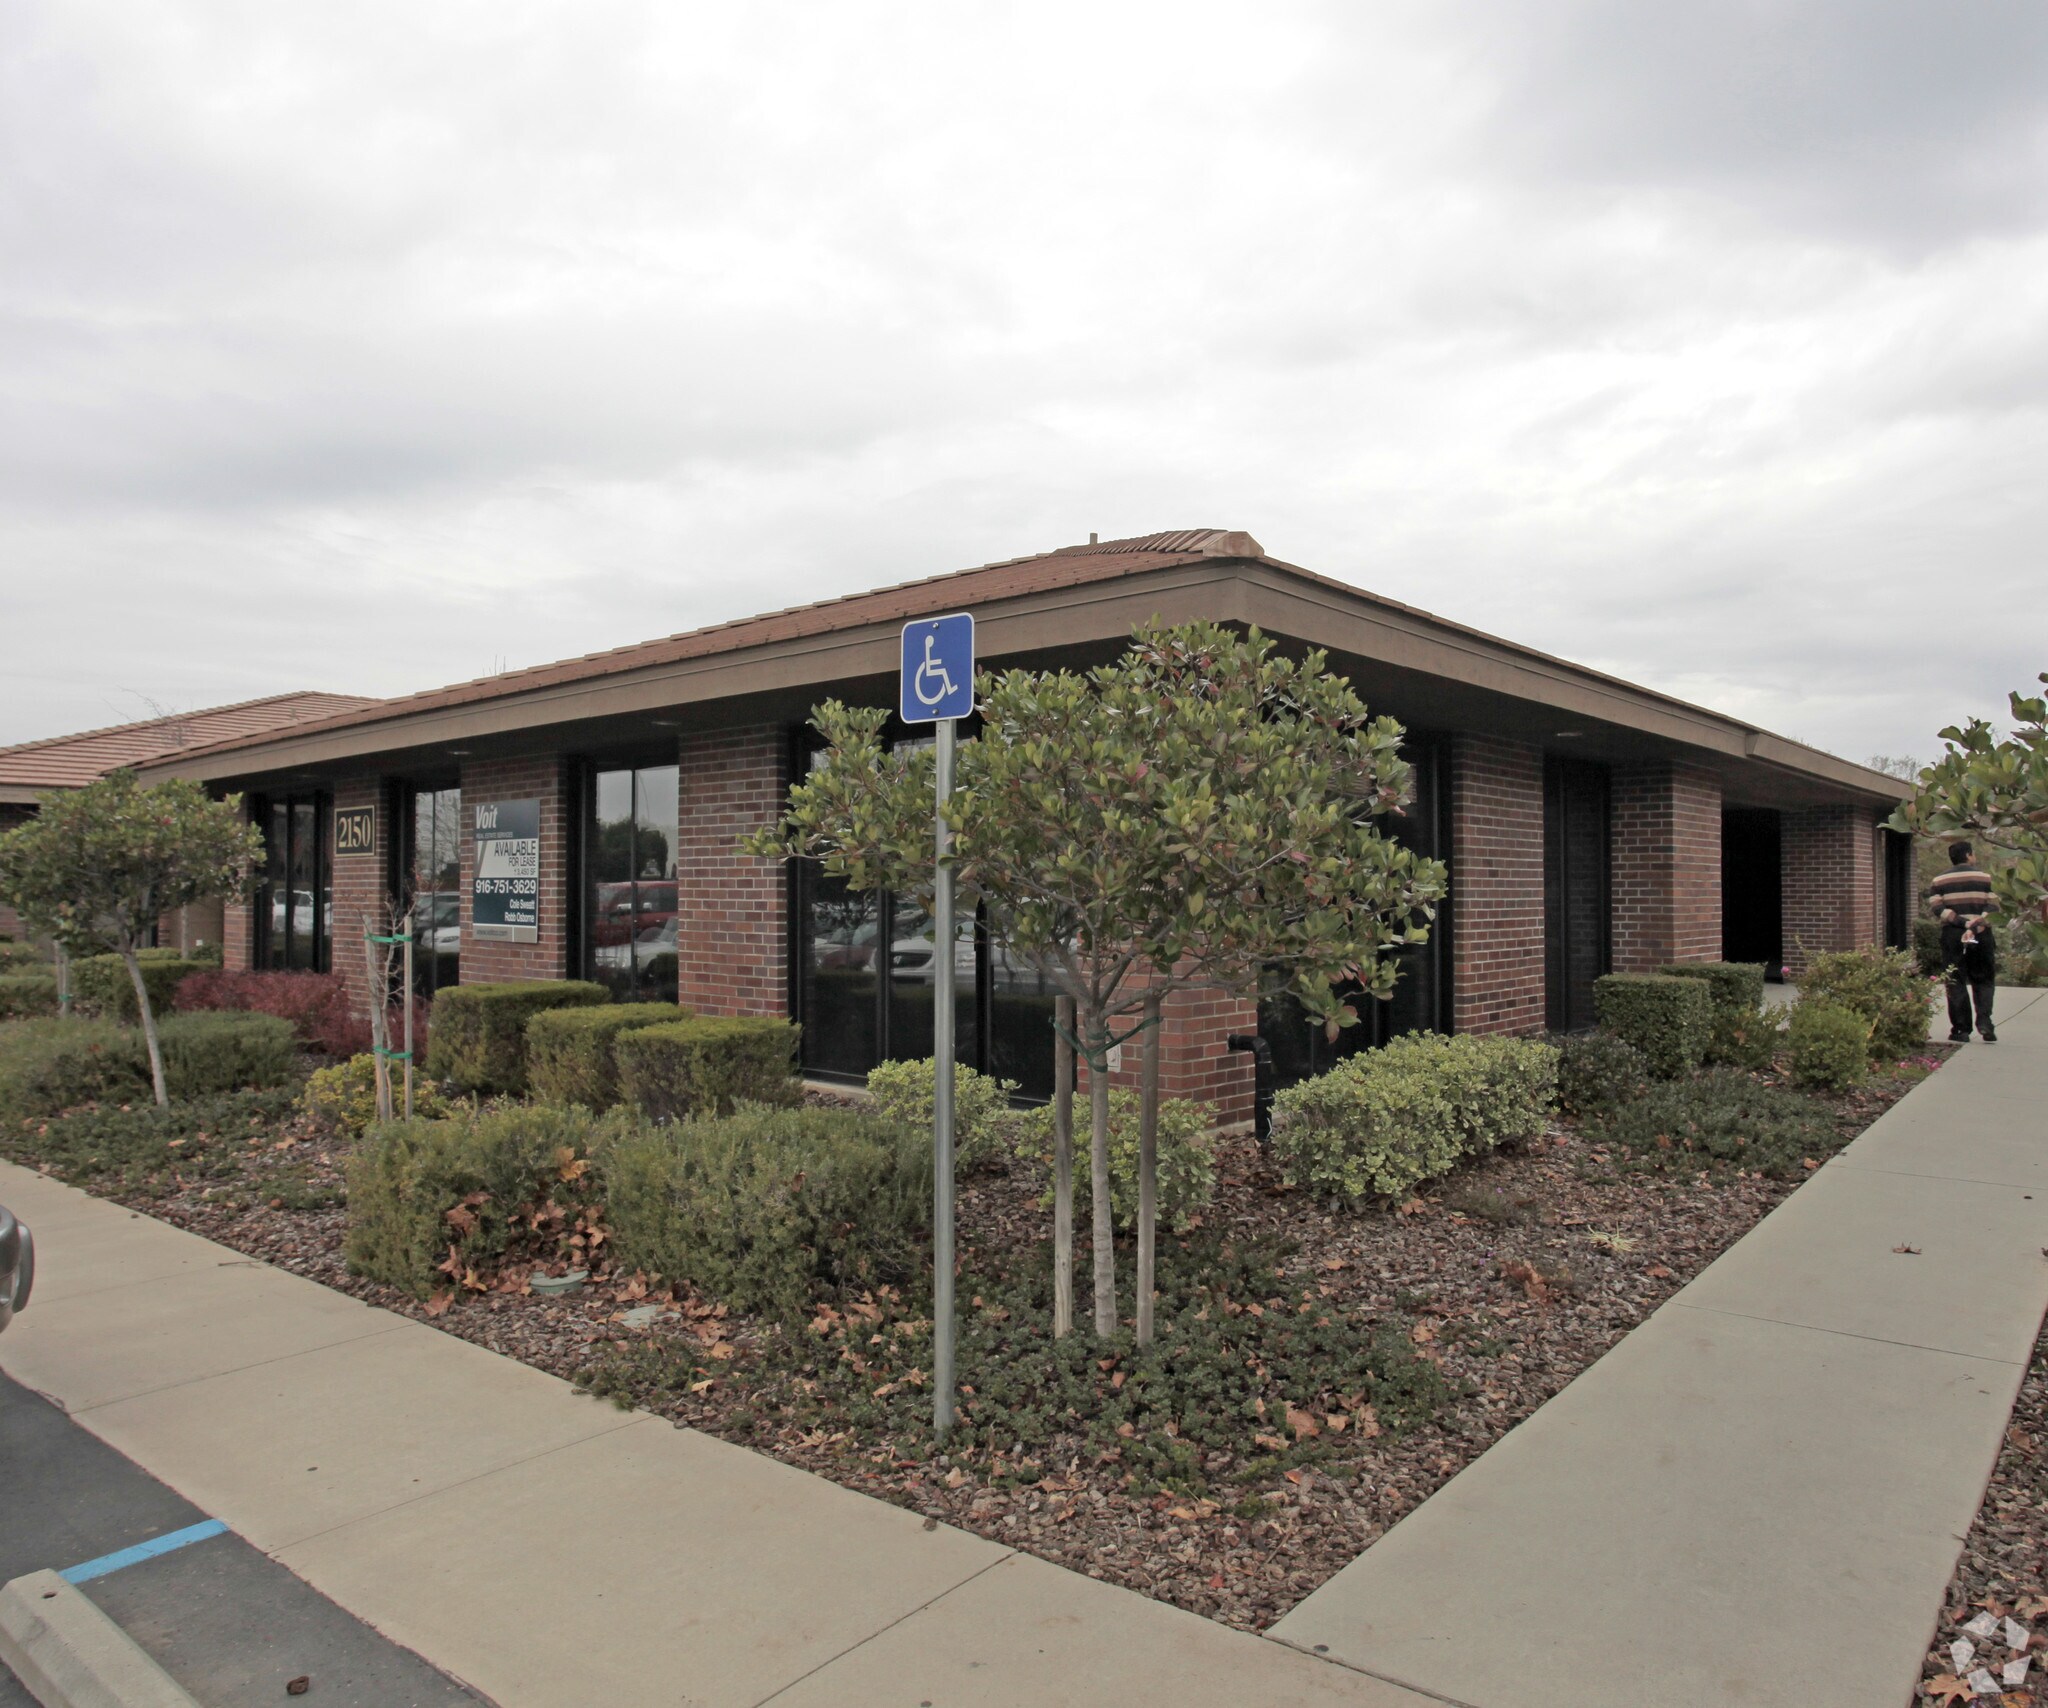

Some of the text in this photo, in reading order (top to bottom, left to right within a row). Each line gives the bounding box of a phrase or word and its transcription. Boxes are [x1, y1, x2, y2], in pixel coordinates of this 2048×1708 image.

[476, 805, 498, 829] Voit
[338, 815, 370, 847] 2150
[494, 841, 536, 856] AVAILABLE
[508, 857, 536, 867] FOR LEASE
[476, 880, 536, 894] 916-751-3629
